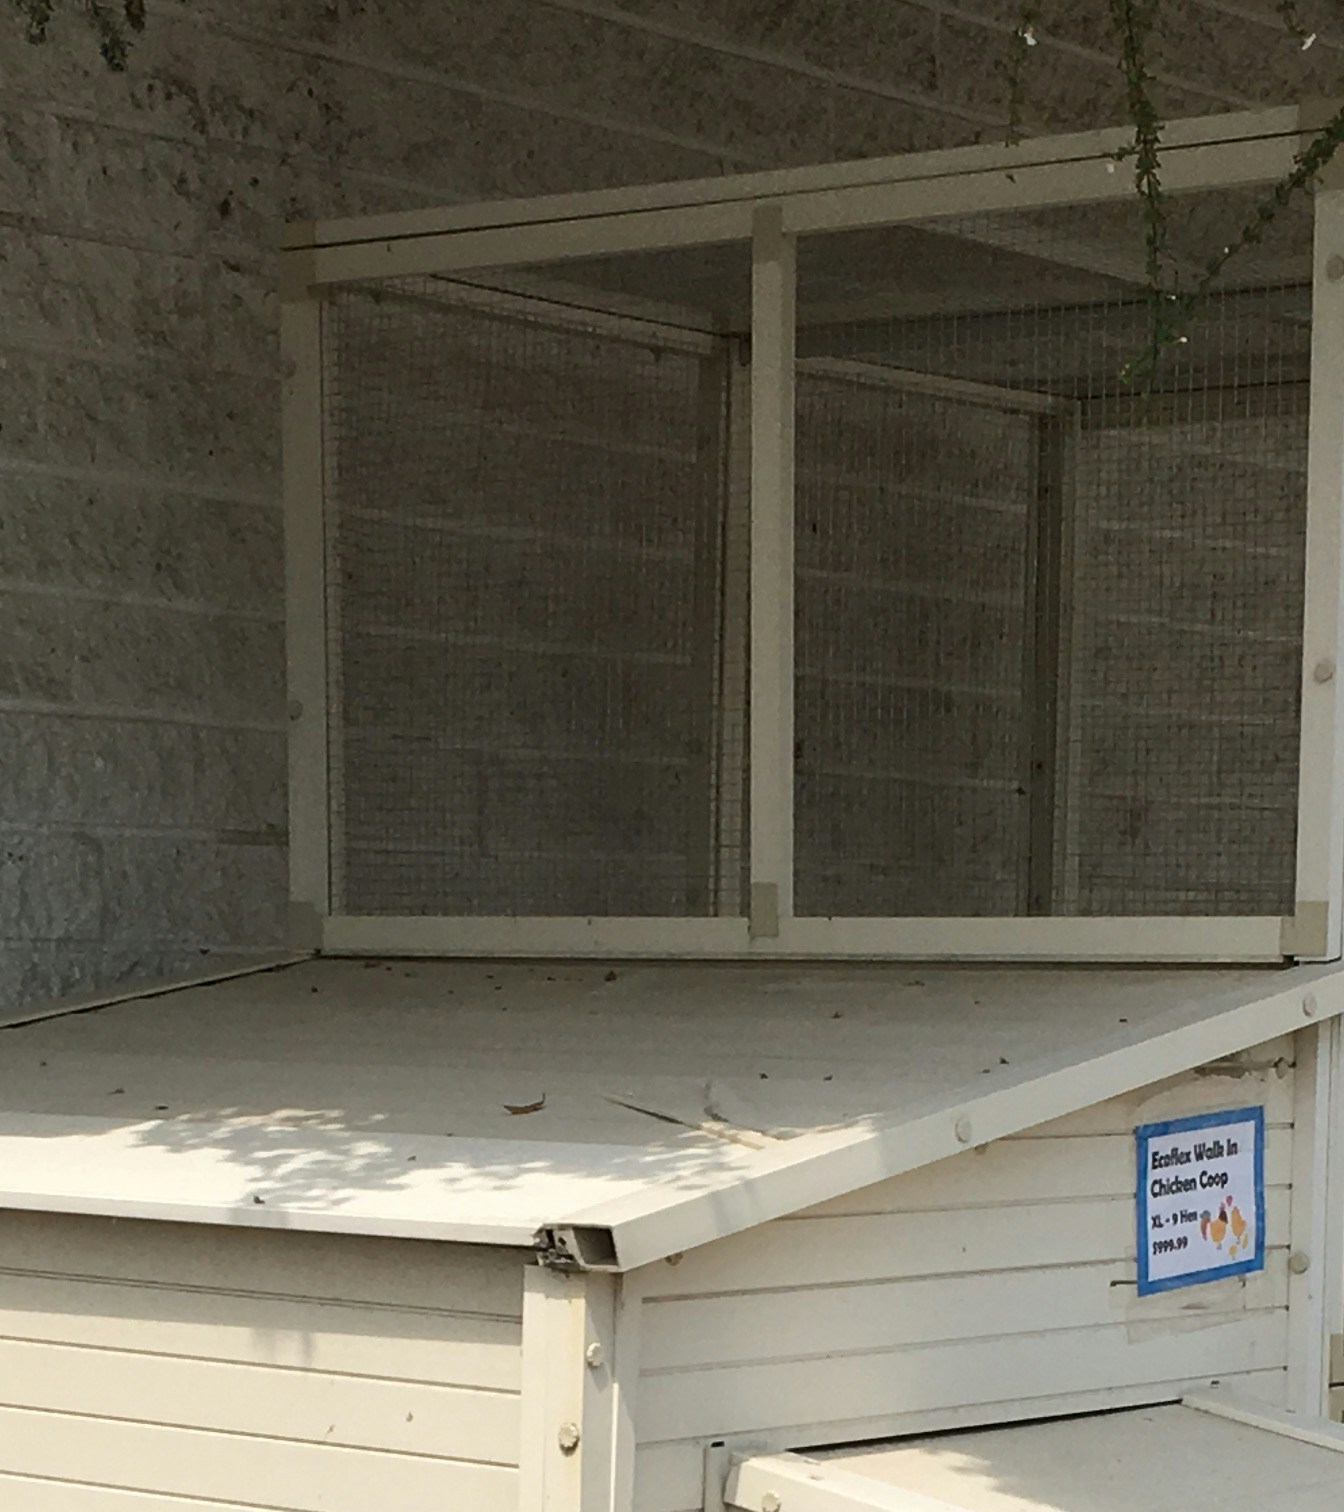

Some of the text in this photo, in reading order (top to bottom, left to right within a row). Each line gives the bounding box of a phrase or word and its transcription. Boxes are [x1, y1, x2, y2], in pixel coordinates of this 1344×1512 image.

[1151, 1147, 1192, 1170] Ecoflex
[1194, 1139, 1224, 1162] Walk
[1150, 1171, 1229, 1198] Chicken Coop
